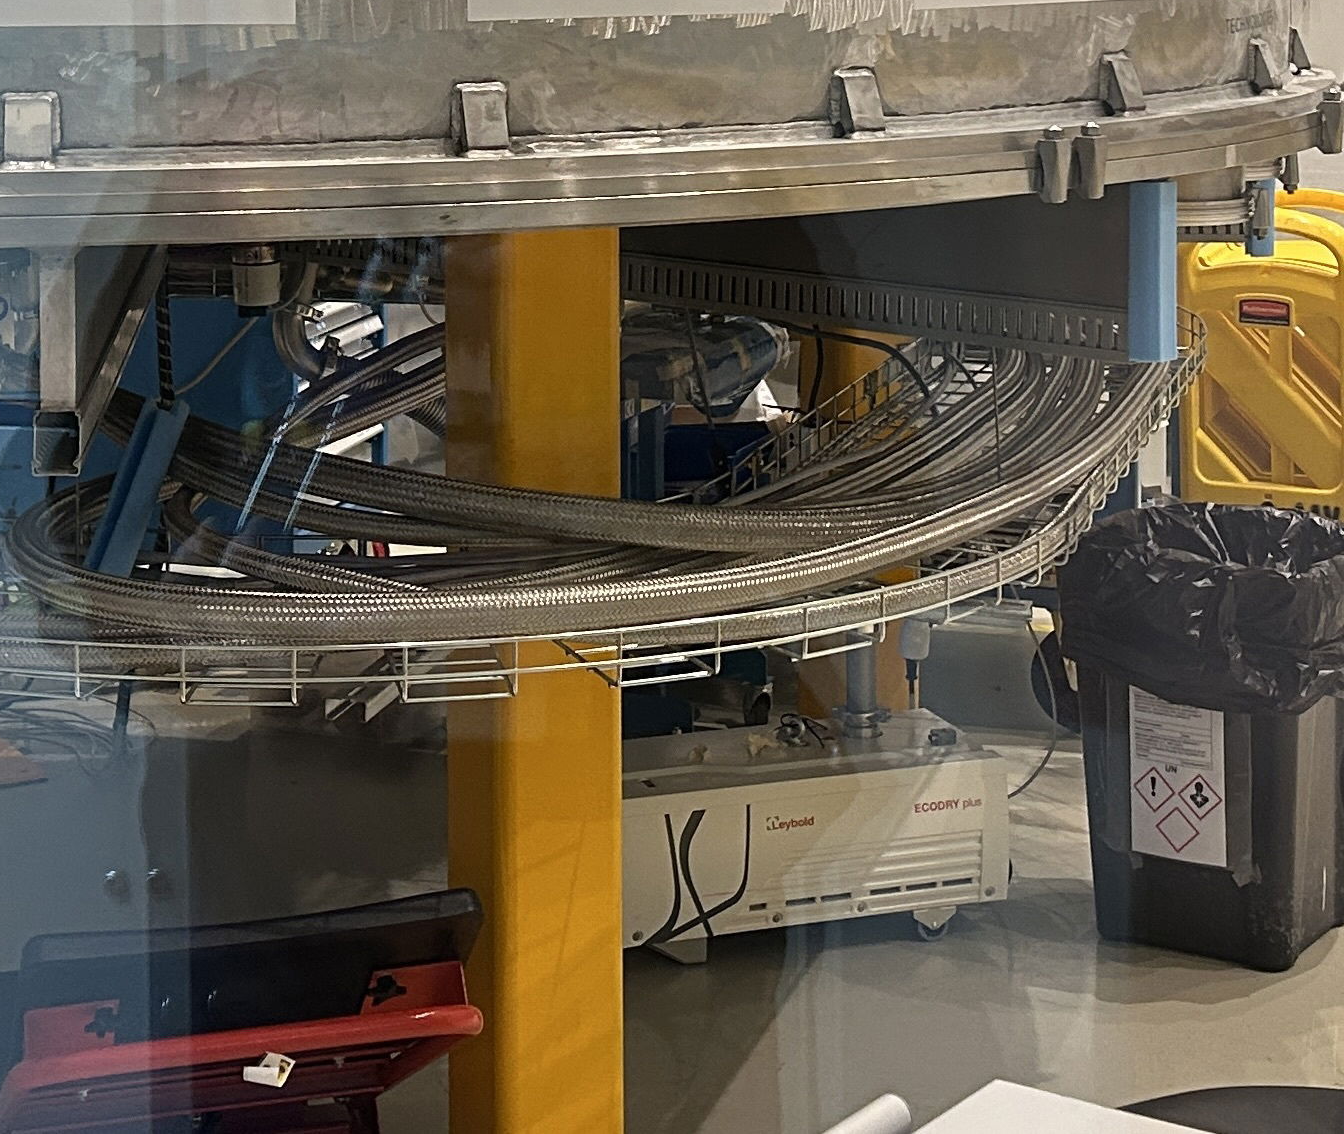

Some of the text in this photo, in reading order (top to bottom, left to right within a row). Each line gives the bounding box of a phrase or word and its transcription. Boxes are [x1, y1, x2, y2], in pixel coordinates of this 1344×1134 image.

[1164, 764, 1178, 774] UN
[914, 797, 983, 814] ECODRY plus
[771, 815, 816, 832] Leybold
